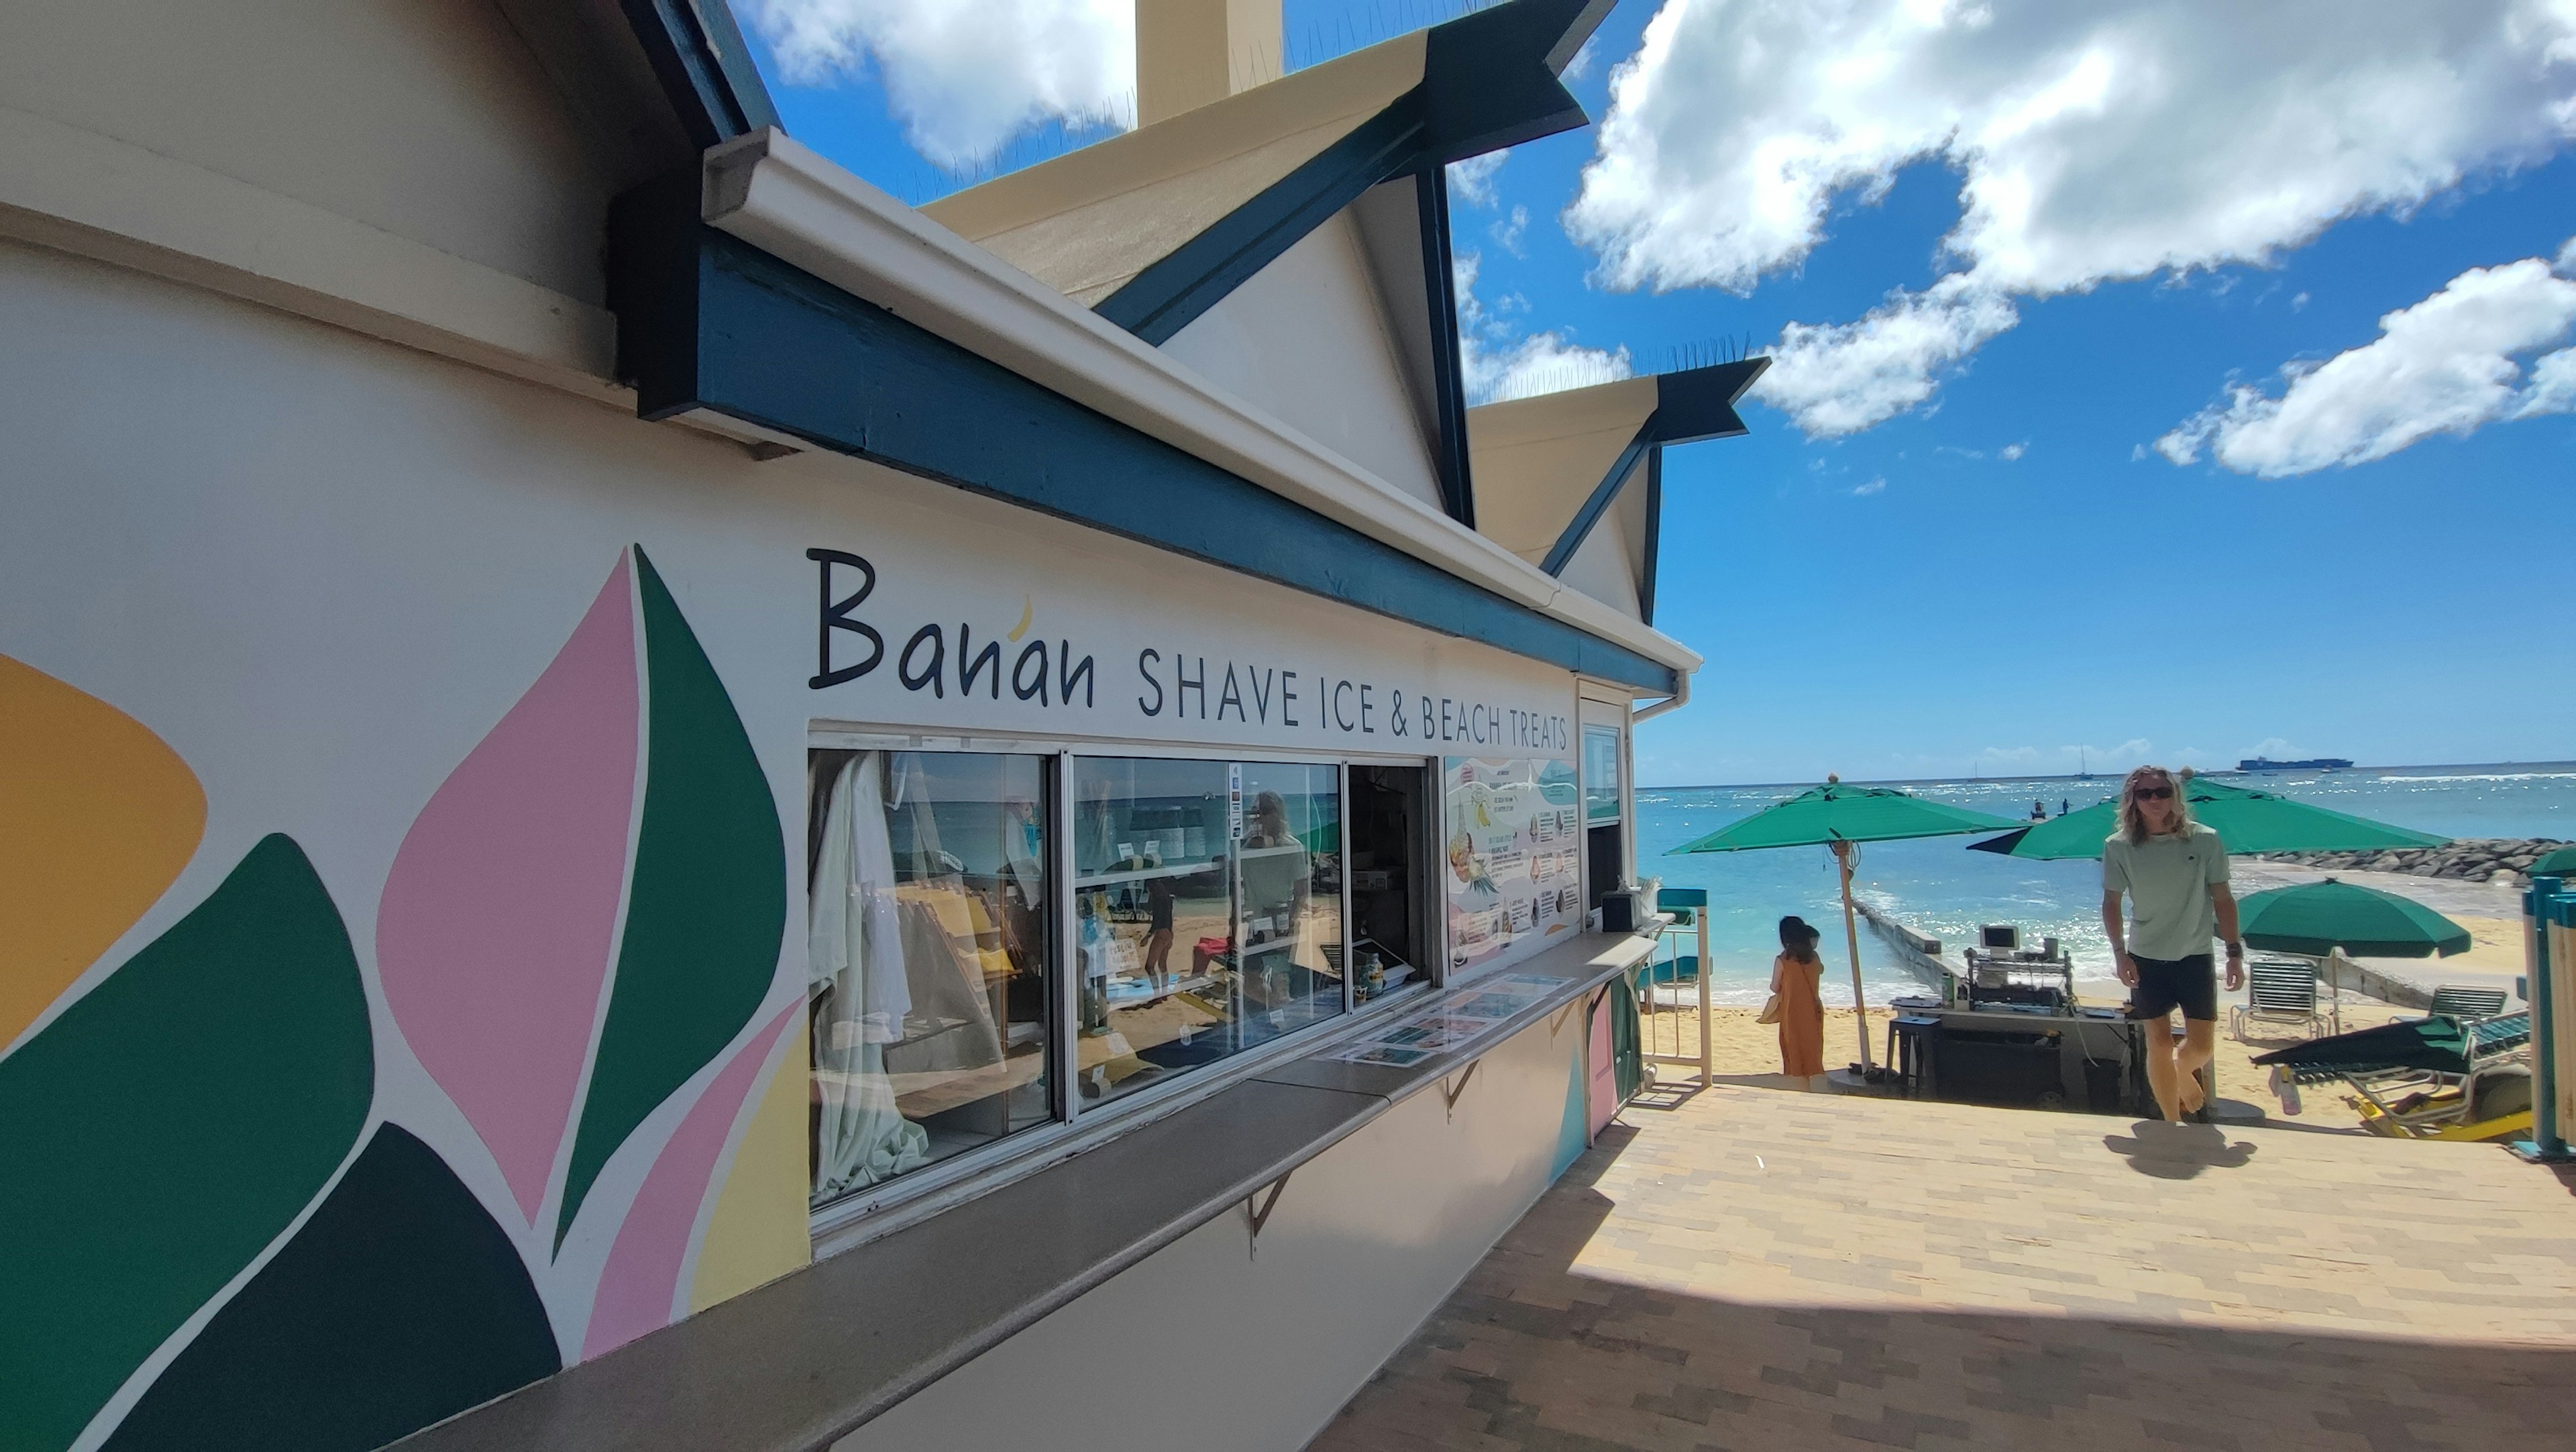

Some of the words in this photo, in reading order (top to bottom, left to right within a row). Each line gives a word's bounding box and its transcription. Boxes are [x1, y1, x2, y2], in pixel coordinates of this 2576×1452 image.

[1138, 648, 1299, 727] SHAVE
[1320, 676, 1375, 734] ICE
[1391, 689, 1409, 737] &
[1421, 695, 1500, 745] BEACH
[1510, 709, 1566, 751] TREATS
